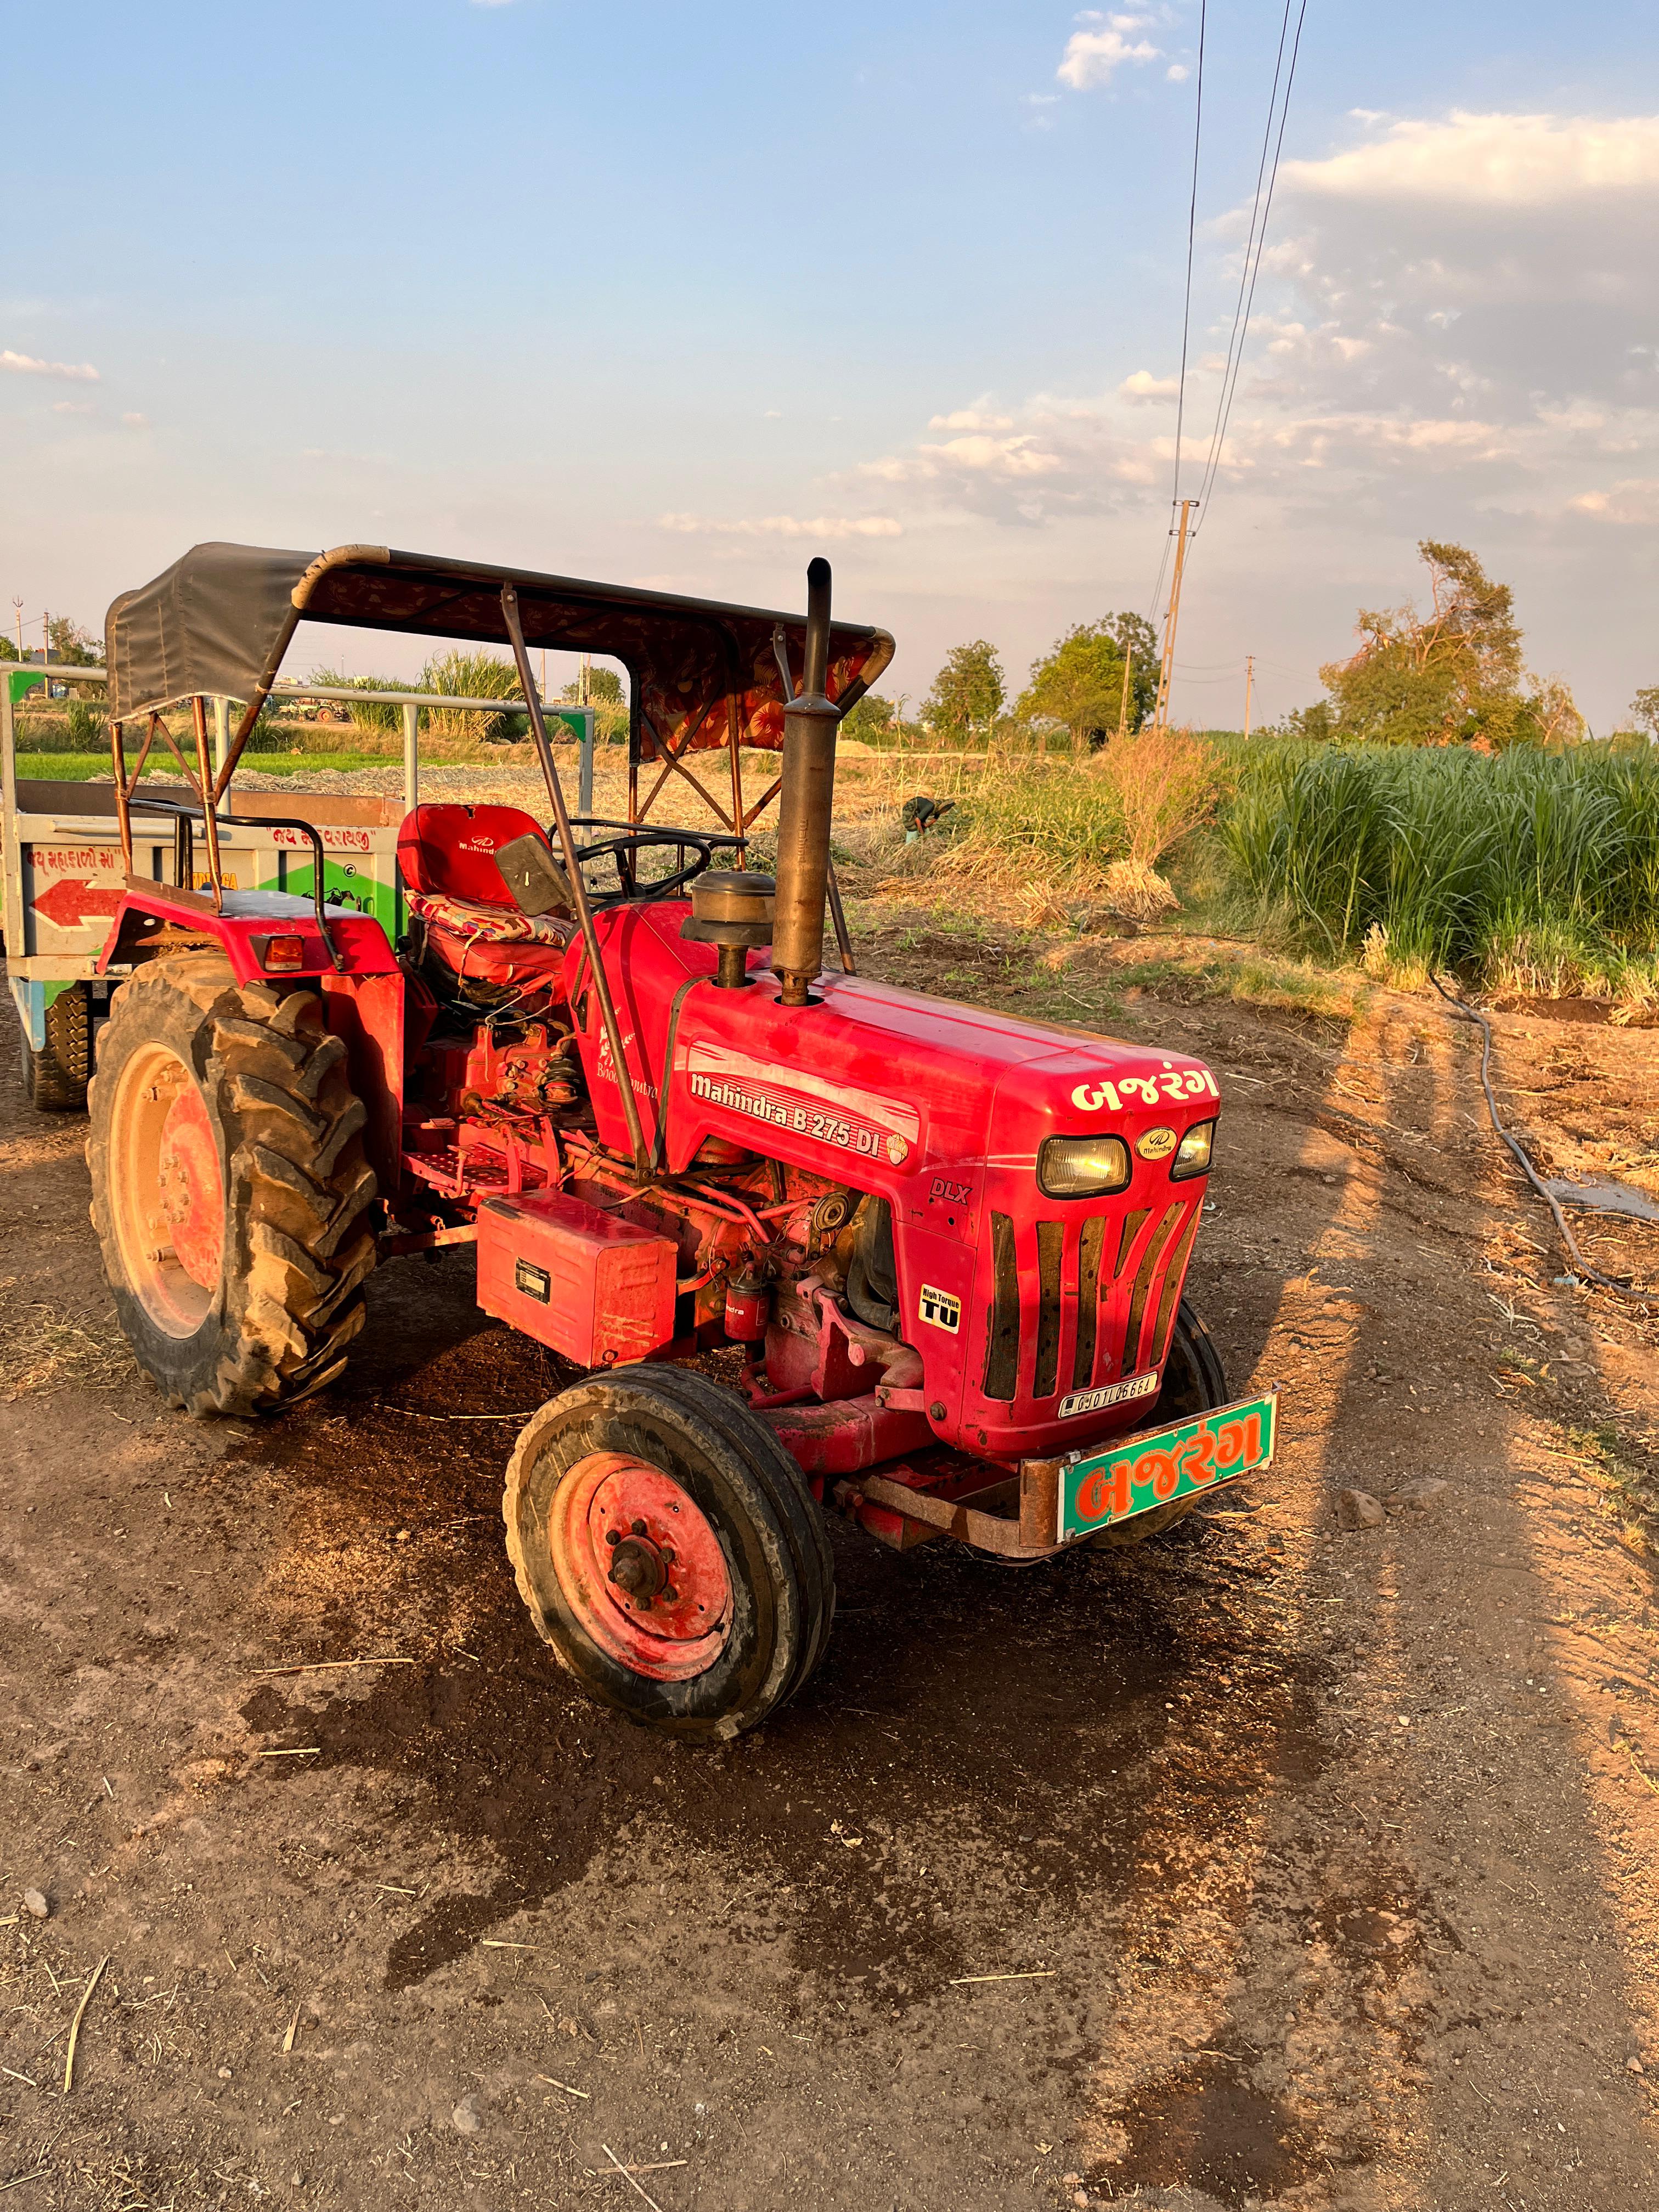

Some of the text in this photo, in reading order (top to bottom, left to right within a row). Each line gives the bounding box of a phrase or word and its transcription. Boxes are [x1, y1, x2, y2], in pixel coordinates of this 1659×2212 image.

[1071, 1061, 1220, 1111] બજરંગ
[691, 1072, 881, 1157] Mahindra B 275 DI
[1143, 1145, 1172, 1155] Mahindra
[930, 1177, 973, 1206] DLX
[922, 1298, 958, 1328] TU
[923, 1288, 960, 1309] High Torque
[1075, 1412, 1263, 1523] બજરંગ
